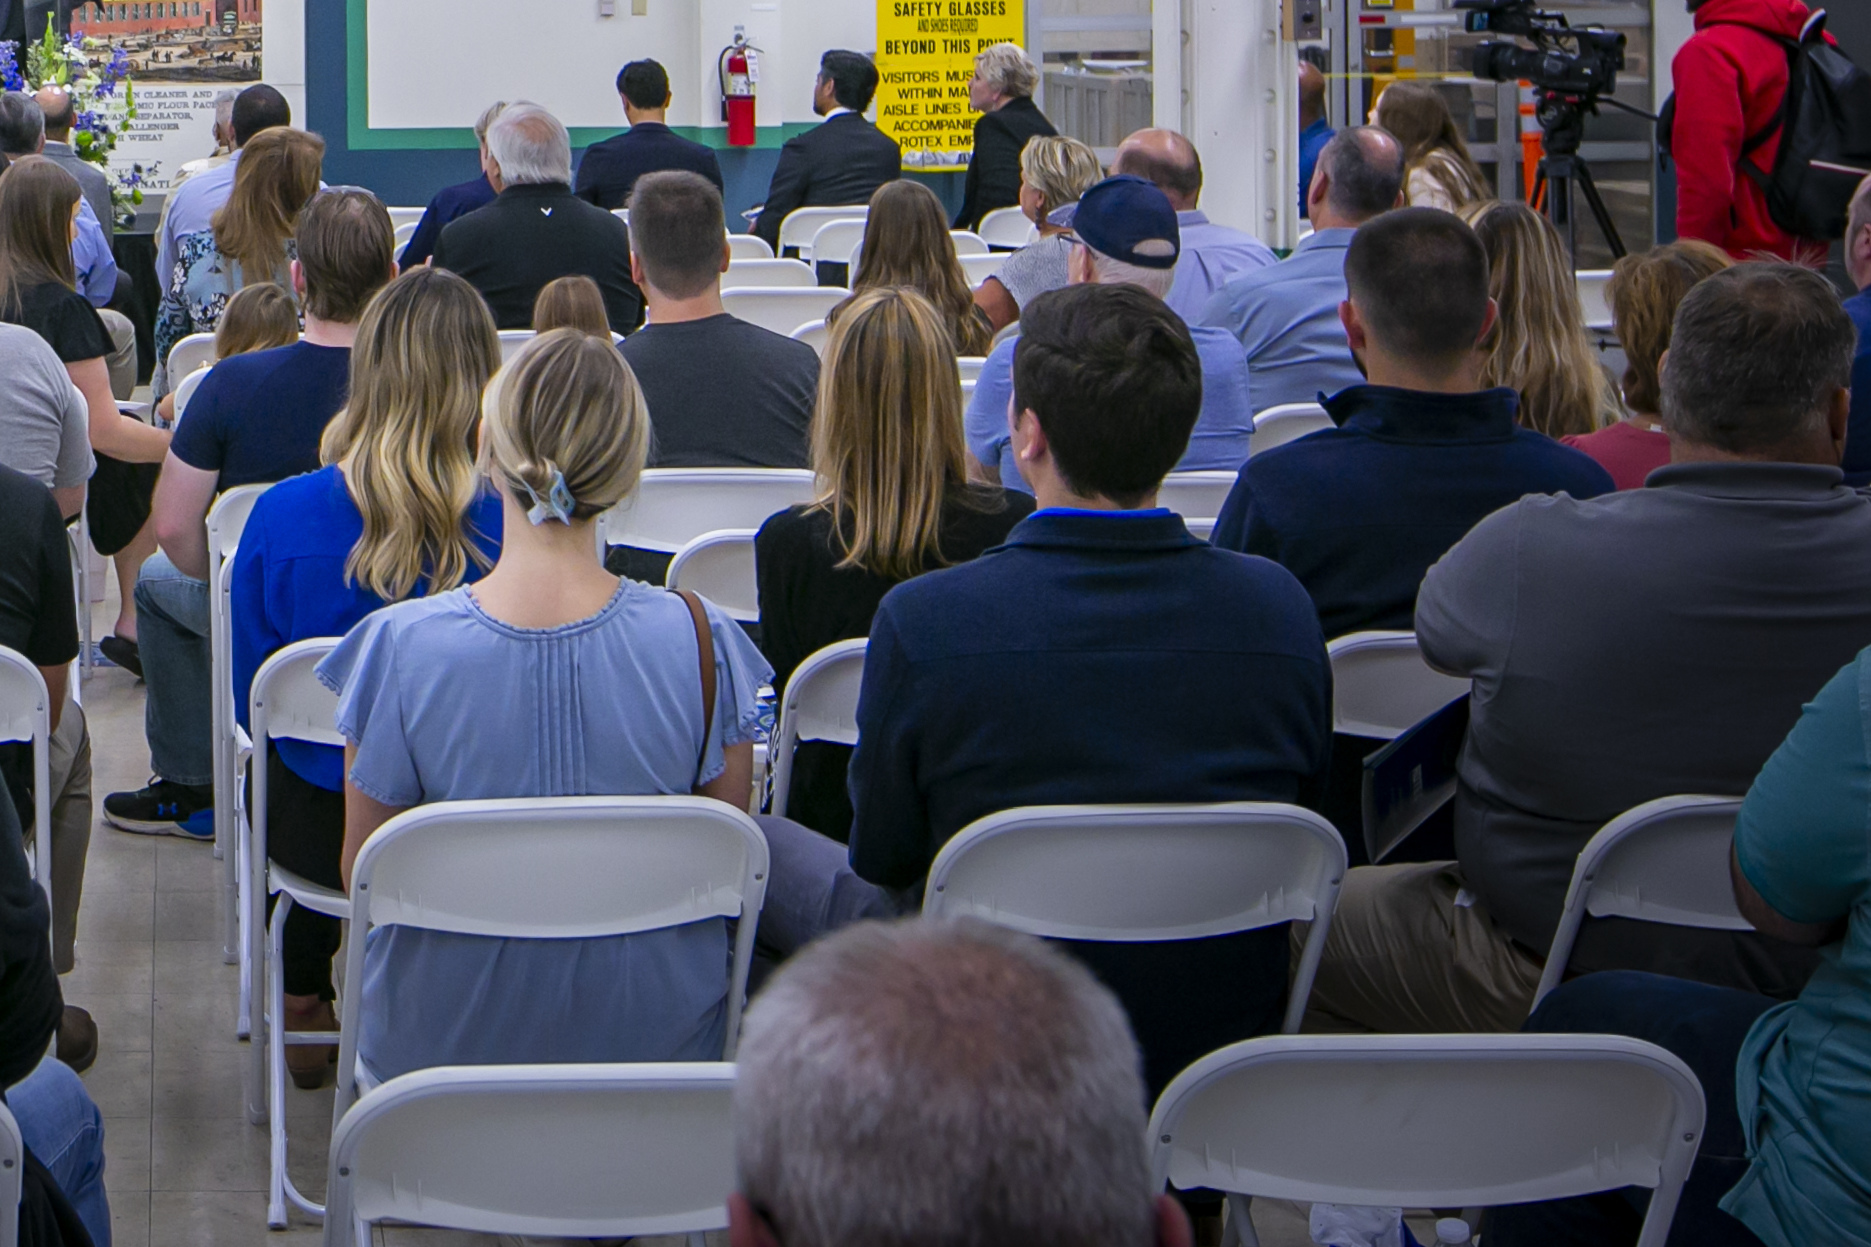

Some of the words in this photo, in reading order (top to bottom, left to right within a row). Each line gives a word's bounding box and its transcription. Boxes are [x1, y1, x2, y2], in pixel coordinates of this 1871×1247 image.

[894, 1, 943, 17] SAFETY
[948, 0, 1006, 16] GLASSES
[917, 19, 929, 33] AND
[930, 18, 949, 33] SHOES
[950, 17, 978, 36] REQUIRED
[885, 39, 936, 55] BEYOND
[942, 38, 971, 54] THIS
[881, 70, 940, 84] VISITORS
[946, 69, 974, 82] MUS
[143, 91, 188, 99] CLEANER
[192, 90, 212, 98] AND
[897, 87, 943, 100] WITHIN
[157, 101, 189, 109] FLOUR
[883, 104, 919, 116] AISLE
[925, 102, 962, 115] LINES
[135, 112, 194, 122] SEPARATOR,
[115, 123, 180, 131] CALLENGER
[893, 118, 975, 132] ACCOMPANIE
[128, 133, 164, 142] WHEAT
[899, 135, 943, 148] ROTEX
